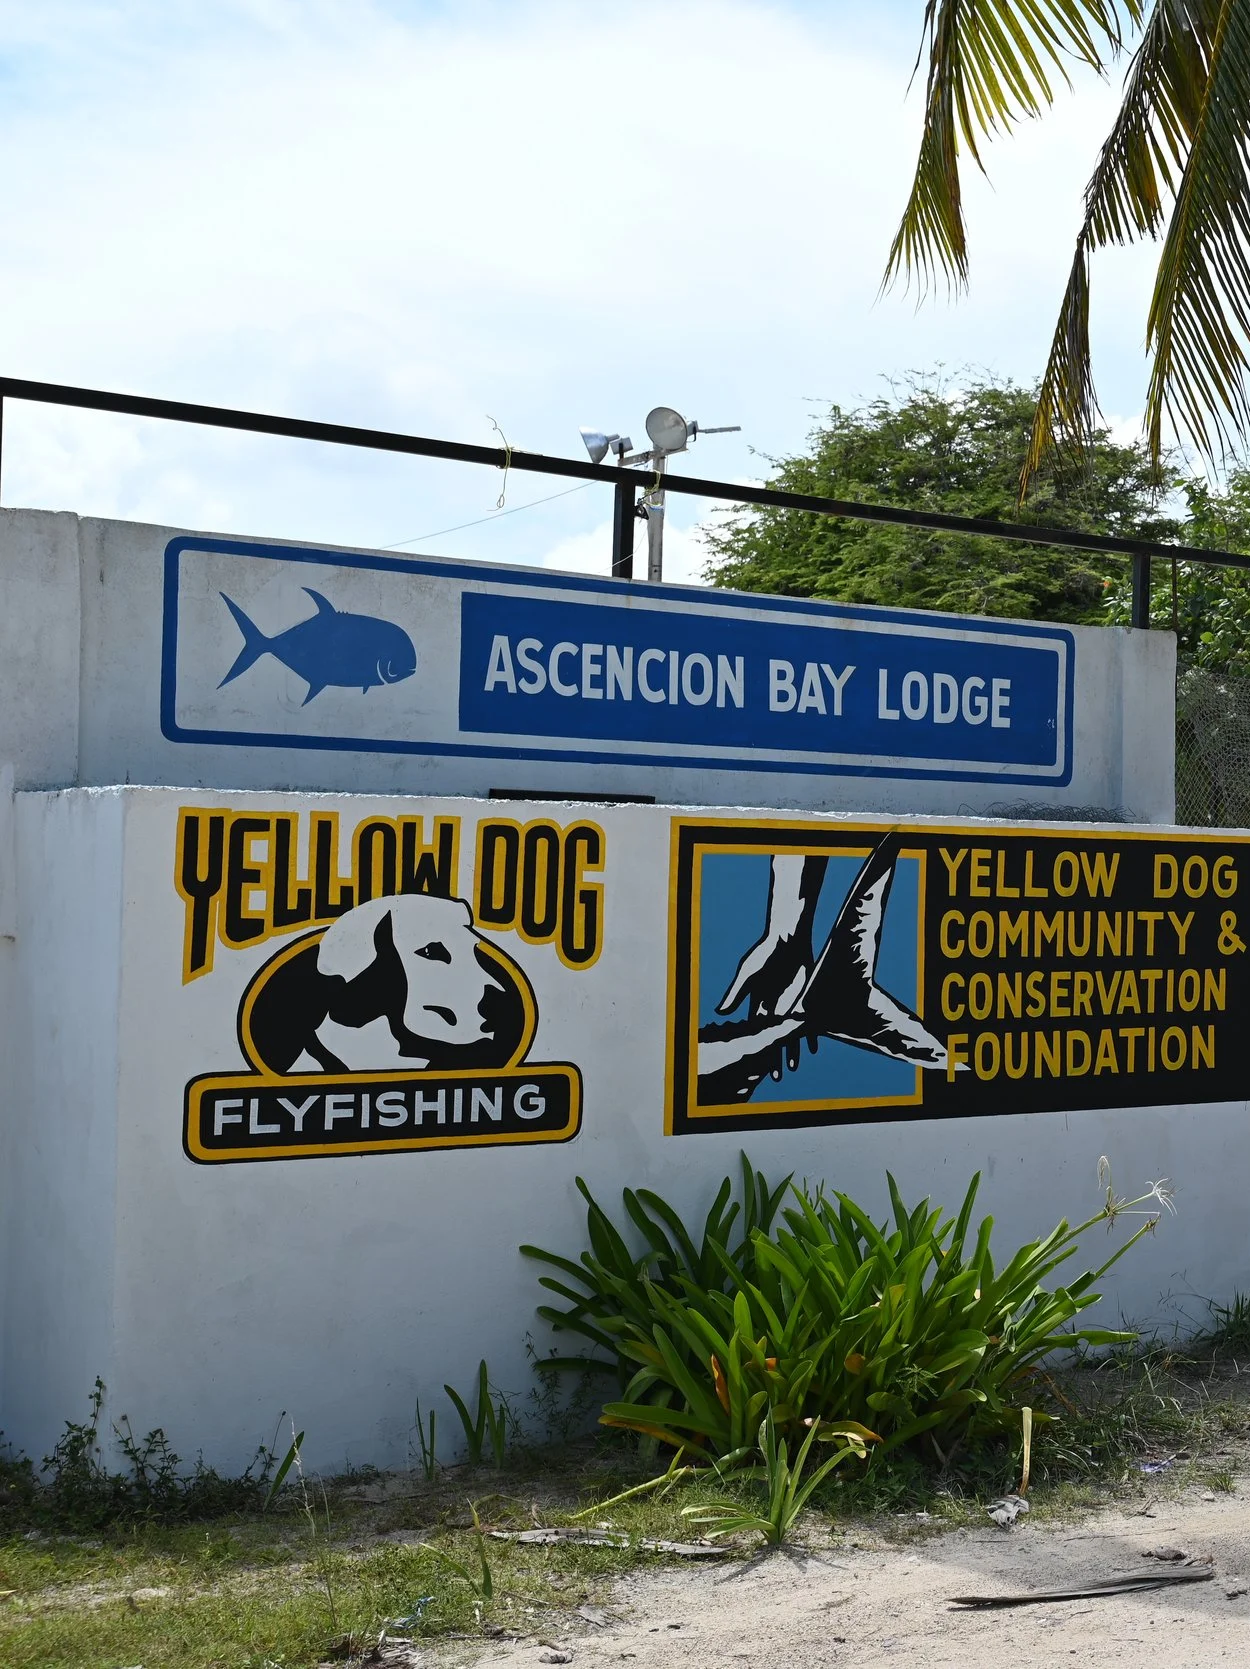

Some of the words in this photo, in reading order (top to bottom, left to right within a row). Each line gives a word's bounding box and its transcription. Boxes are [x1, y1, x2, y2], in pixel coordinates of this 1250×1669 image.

[484, 634, 746, 709] ASCENCION
[769, 658, 857, 717] BAY
[878, 667, 1012, 729] LODGE
[174, 807, 461, 986] YELLOW
[475, 818, 607, 971] DOG
[939, 847, 1120, 899] YELLOW
[1153, 853, 1239, 899] DOG
[939, 909, 1195, 959] COMMUNITY
[1217, 909, 1247, 956] &
[940, 967, 1227, 1021] CONSERVATION
[946, 1024, 1216, 1083] FOUNDATION
[213, 1084, 547, 1136] FLYFISHING
